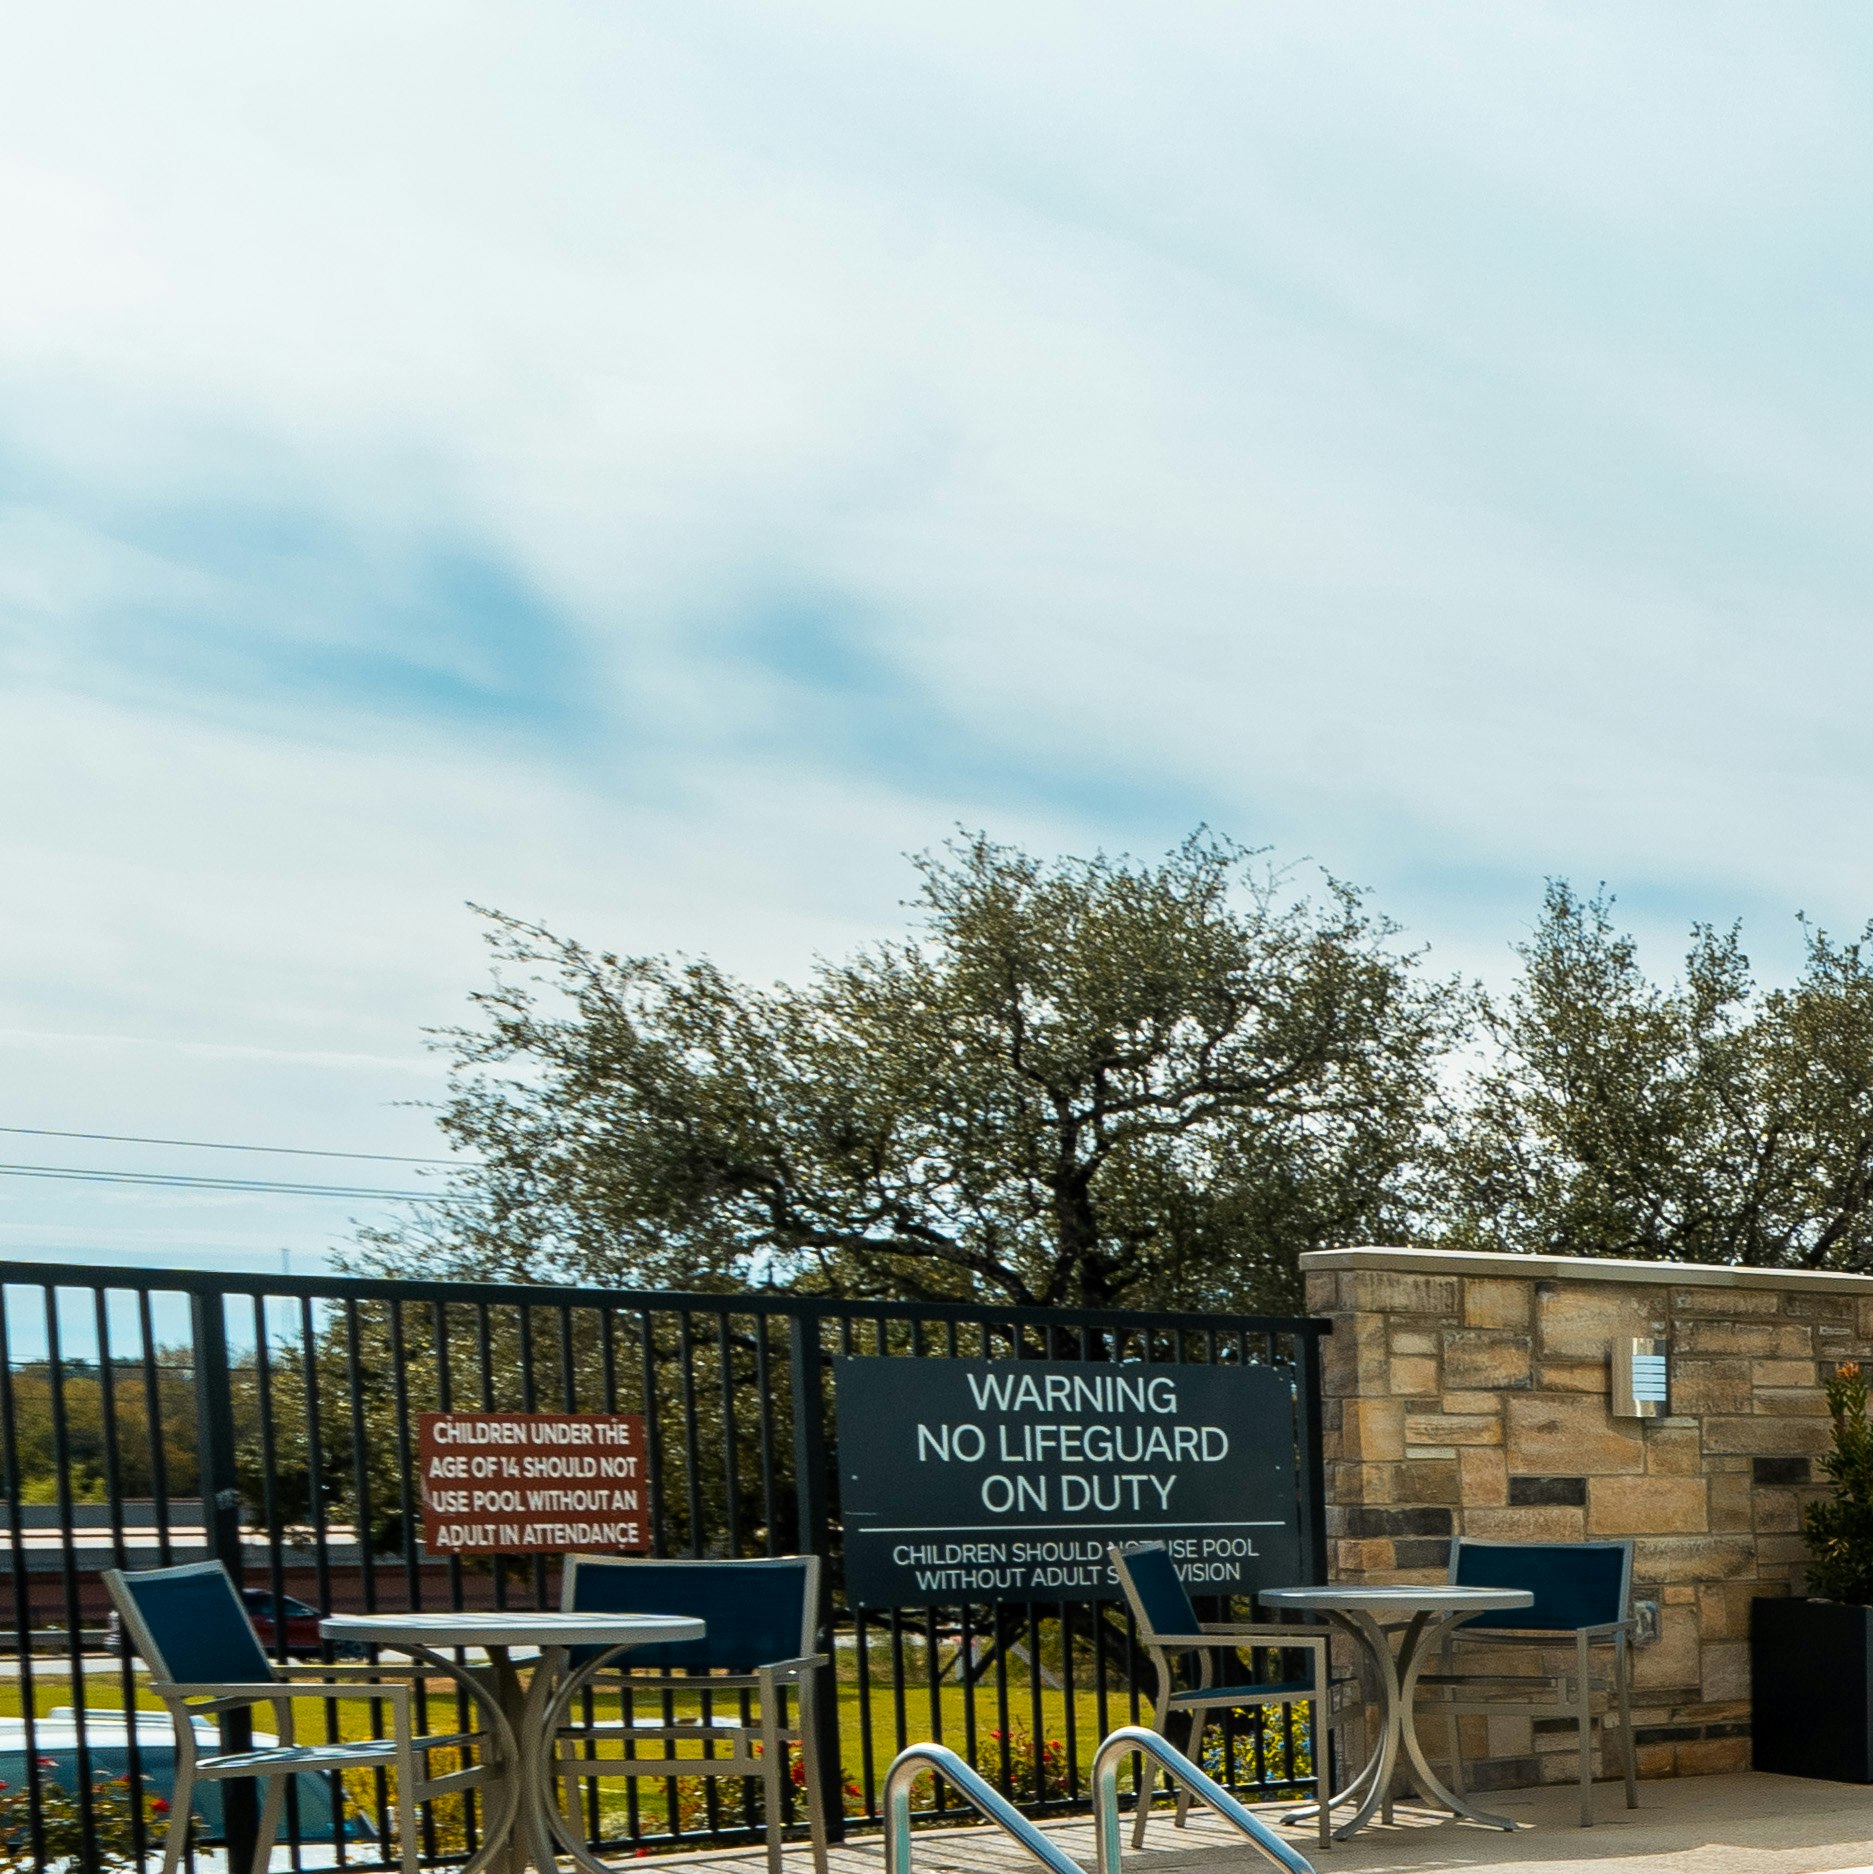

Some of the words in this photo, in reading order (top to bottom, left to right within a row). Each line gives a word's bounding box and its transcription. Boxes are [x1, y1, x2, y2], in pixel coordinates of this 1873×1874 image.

[967, 1374, 1177, 1413] WARNING
[433, 1422, 527, 1444] CHILDREN
[531, 1423, 593, 1444] UNDER
[594, 1424, 629, 1444] THE
[918, 1424, 985, 1462] NO
[1000, 1425, 1228, 1461] LIFEGUARD
[429, 1457, 468, 1478] AGE
[471, 1457, 497, 1478] OF
[500, 1457, 520, 1477] 14
[523, 1457, 597, 1478] SHOULD
[600, 1457, 637, 1477] NOT
[432, 1491, 469, 1512] USE
[473, 1491, 525, 1511] POOL
[526, 1490, 610, 1511] WITHOUT
[611, 1490, 638, 1510] AN
[982, 1475, 1046, 1512] ON
[1062, 1475, 1177, 1511] DUTY
[437, 1524, 496, 1546] ADULT
[499, 1524, 520, 1545] IN
[523, 1523, 639, 1545] ATTENDANCE
[893, 1544, 1006, 1565] CHILDREN
[1013, 1542, 1102, 1562] SHOULD
[1203, 1539, 1259, 1557] POOL
[916, 1568, 1024, 1591] WITHOUT
[1031, 1566, 1102, 1586] ADULT
[1106, 1562, 1241, 1585] SVISION
